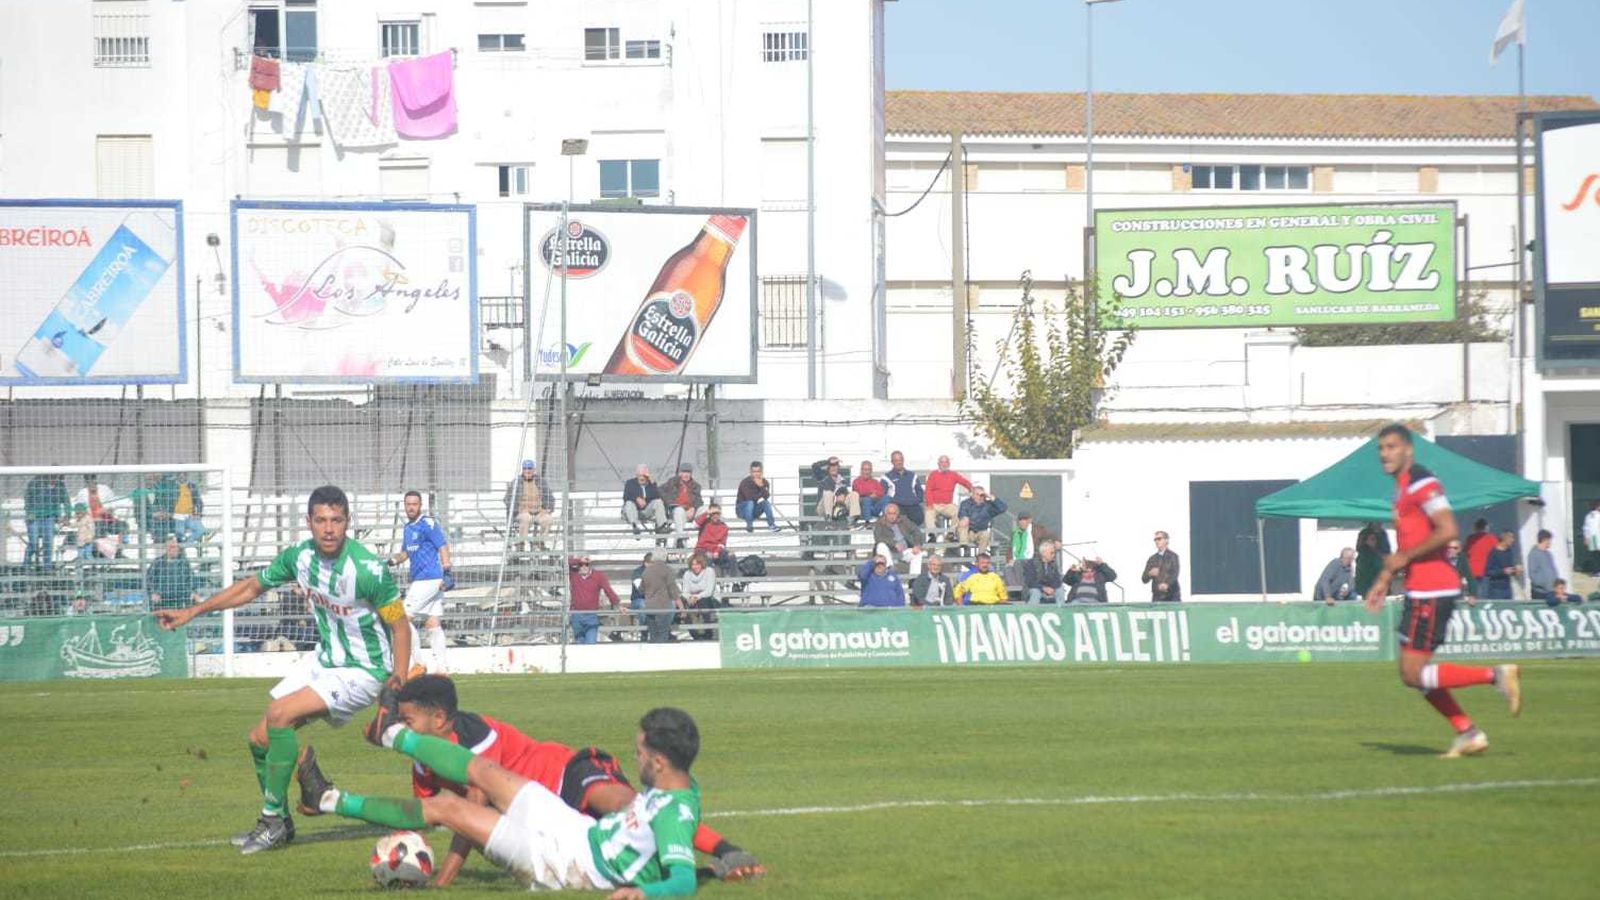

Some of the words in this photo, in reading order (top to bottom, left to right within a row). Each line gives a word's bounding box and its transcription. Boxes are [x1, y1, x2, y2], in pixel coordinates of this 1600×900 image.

[1112, 218, 1244, 232] CONSTRUCCIONES
[1247, 217, 1266, 229] EN
[1269, 215, 1340, 228] GENERAL
[1342, 215, 1352, 226] Y
[1354, 214, 1396, 226] OBRA
[1398, 213, 1439, 225] CIVIL
[548, 236, 602, 251] Estrella
[1113, 248, 1250, 297] J.M.
[1264, 230, 1440, 294] RUÍZ
[313, 274, 355, 300] Los
[364, 273, 461, 314] Angeles
[1221, 305, 1244, 315] 380
[1248, 305, 1271, 315] 325
[639, 320, 682, 360] Galicia
[644, 305, 693, 347] Estrella
[736, 624, 762, 652] el
[769, 627, 910, 657] gatonauta
[932, 612, 1067, 663] ¡VAMOS
[1073, 610, 1191, 661] ATLETI!
[1215, 617, 1239, 644] el
[1246, 621, 1380, 650] gatonauta
